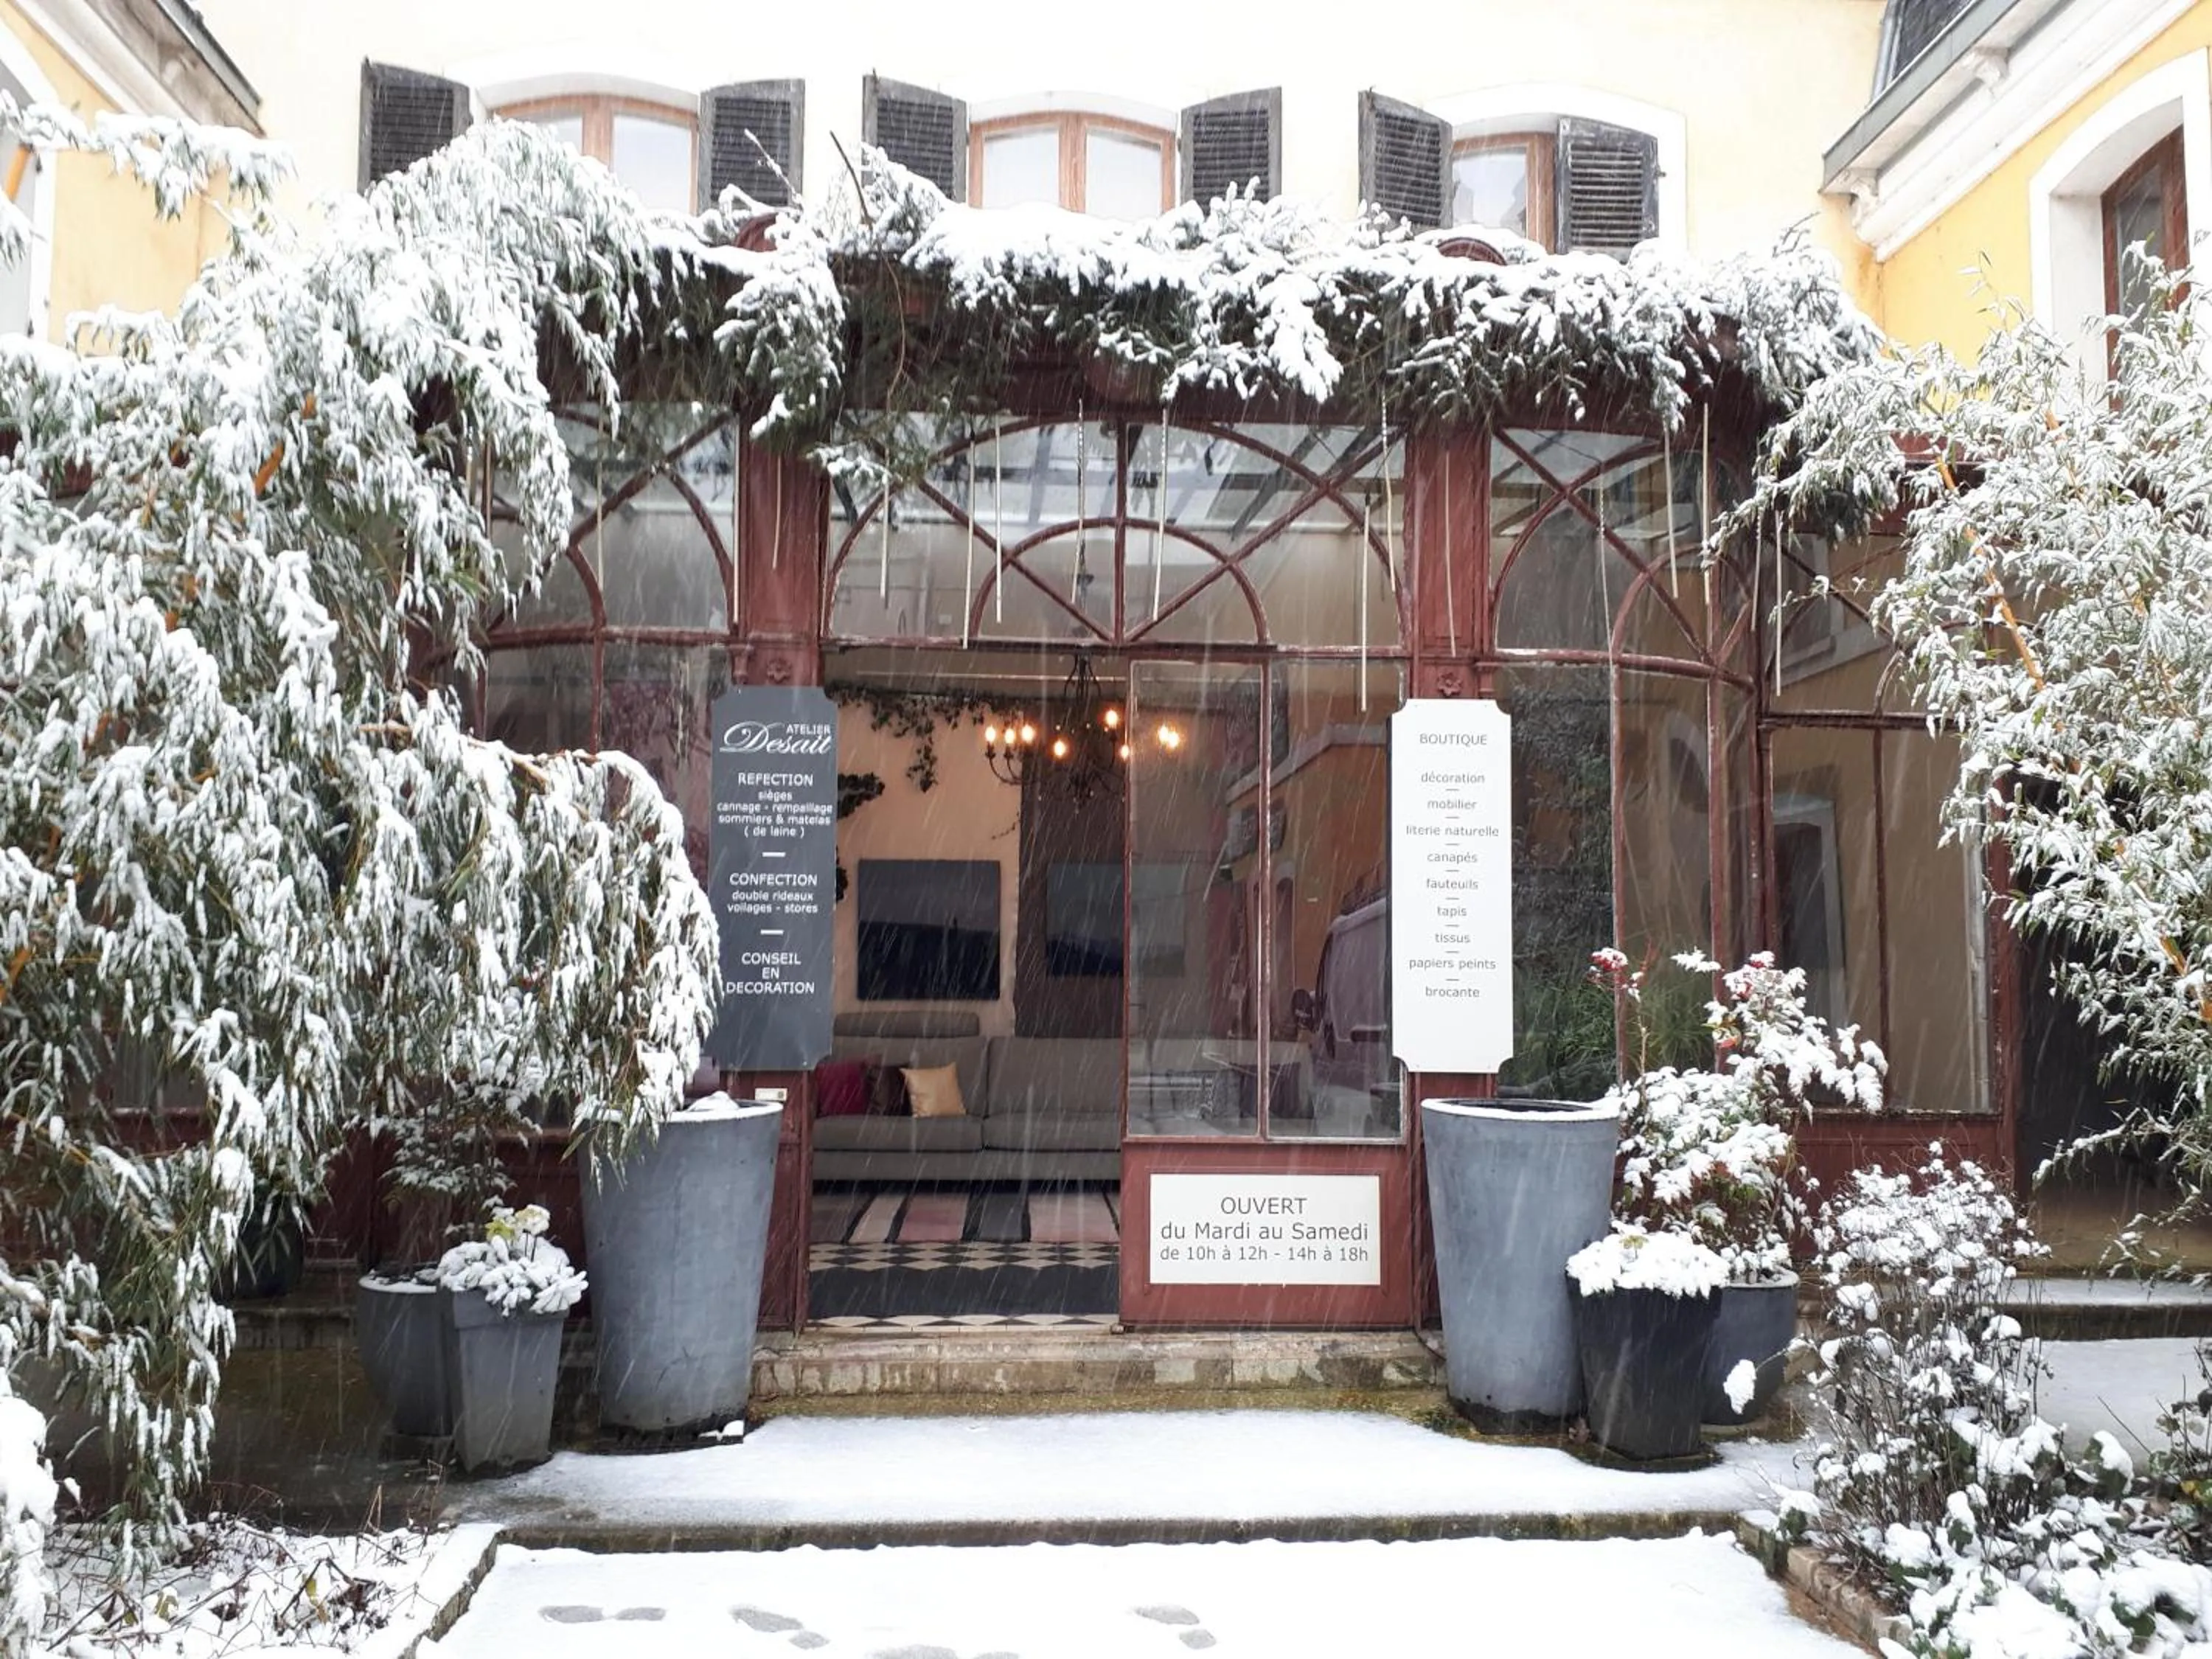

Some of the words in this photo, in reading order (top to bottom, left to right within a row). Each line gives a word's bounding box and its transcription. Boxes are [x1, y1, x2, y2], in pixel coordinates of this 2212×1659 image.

[786, 724, 830, 734] ATELIER
[720, 721, 832, 754] Desait
[1419, 734, 1487, 747] BOUTIQUE
[738, 773, 814, 786] REFECTION
[1421, 771, 1485, 784] décoration
[758, 789, 793, 801] sièges
[717, 802, 761, 813] cannage
[772, 803, 832, 815] rempaillage
[1427, 799, 1477, 810] mobilier
[719, 814, 771, 824] sommiers
[776, 815, 784, 824] &
[787, 815, 831, 825] matelas
[1406, 826, 1440, 835] literie
[1445, 826, 1499, 837] naturelle
[1427, 852, 1478, 864] canapés
[729, 873, 818, 886] CONFECTION
[1426, 878, 1479, 890] fauteuils
[732, 891, 768, 901] double
[773, 891, 813, 901] rideaux
[727, 903, 772, 914] voilages
[785, 903, 818, 913] stores
[1437, 906, 1467, 917] tapis
[1435, 933, 1470, 943] tissus
[742, 953, 801, 964] CONSEIL
[1409, 959, 1455, 970] papiers
[1458, 959, 1496, 970] peints
[762, 967, 779, 979] EN
[726, 982, 815, 994] DECORATION
[1425, 987, 1480, 998] brocante
[1220, 1197, 1307, 1214] OUVERT
[1161, 1221, 1185, 1239] du
[1195, 1222, 1251, 1239] Mardi
[1259, 1225, 1283, 1239] au
[1292, 1222, 1368, 1240] Samedi
[1160, 1246, 1179, 1260] de
[1187, 1246, 1216, 1260] 10h
[1222, 1245, 1231, 1260] à
[1239, 1246, 1267, 1260] 12h
[1289, 1246, 1316, 1261] 14h
[1324, 1246, 1332, 1261] à
[1340, 1246, 1368, 1262] 18h
